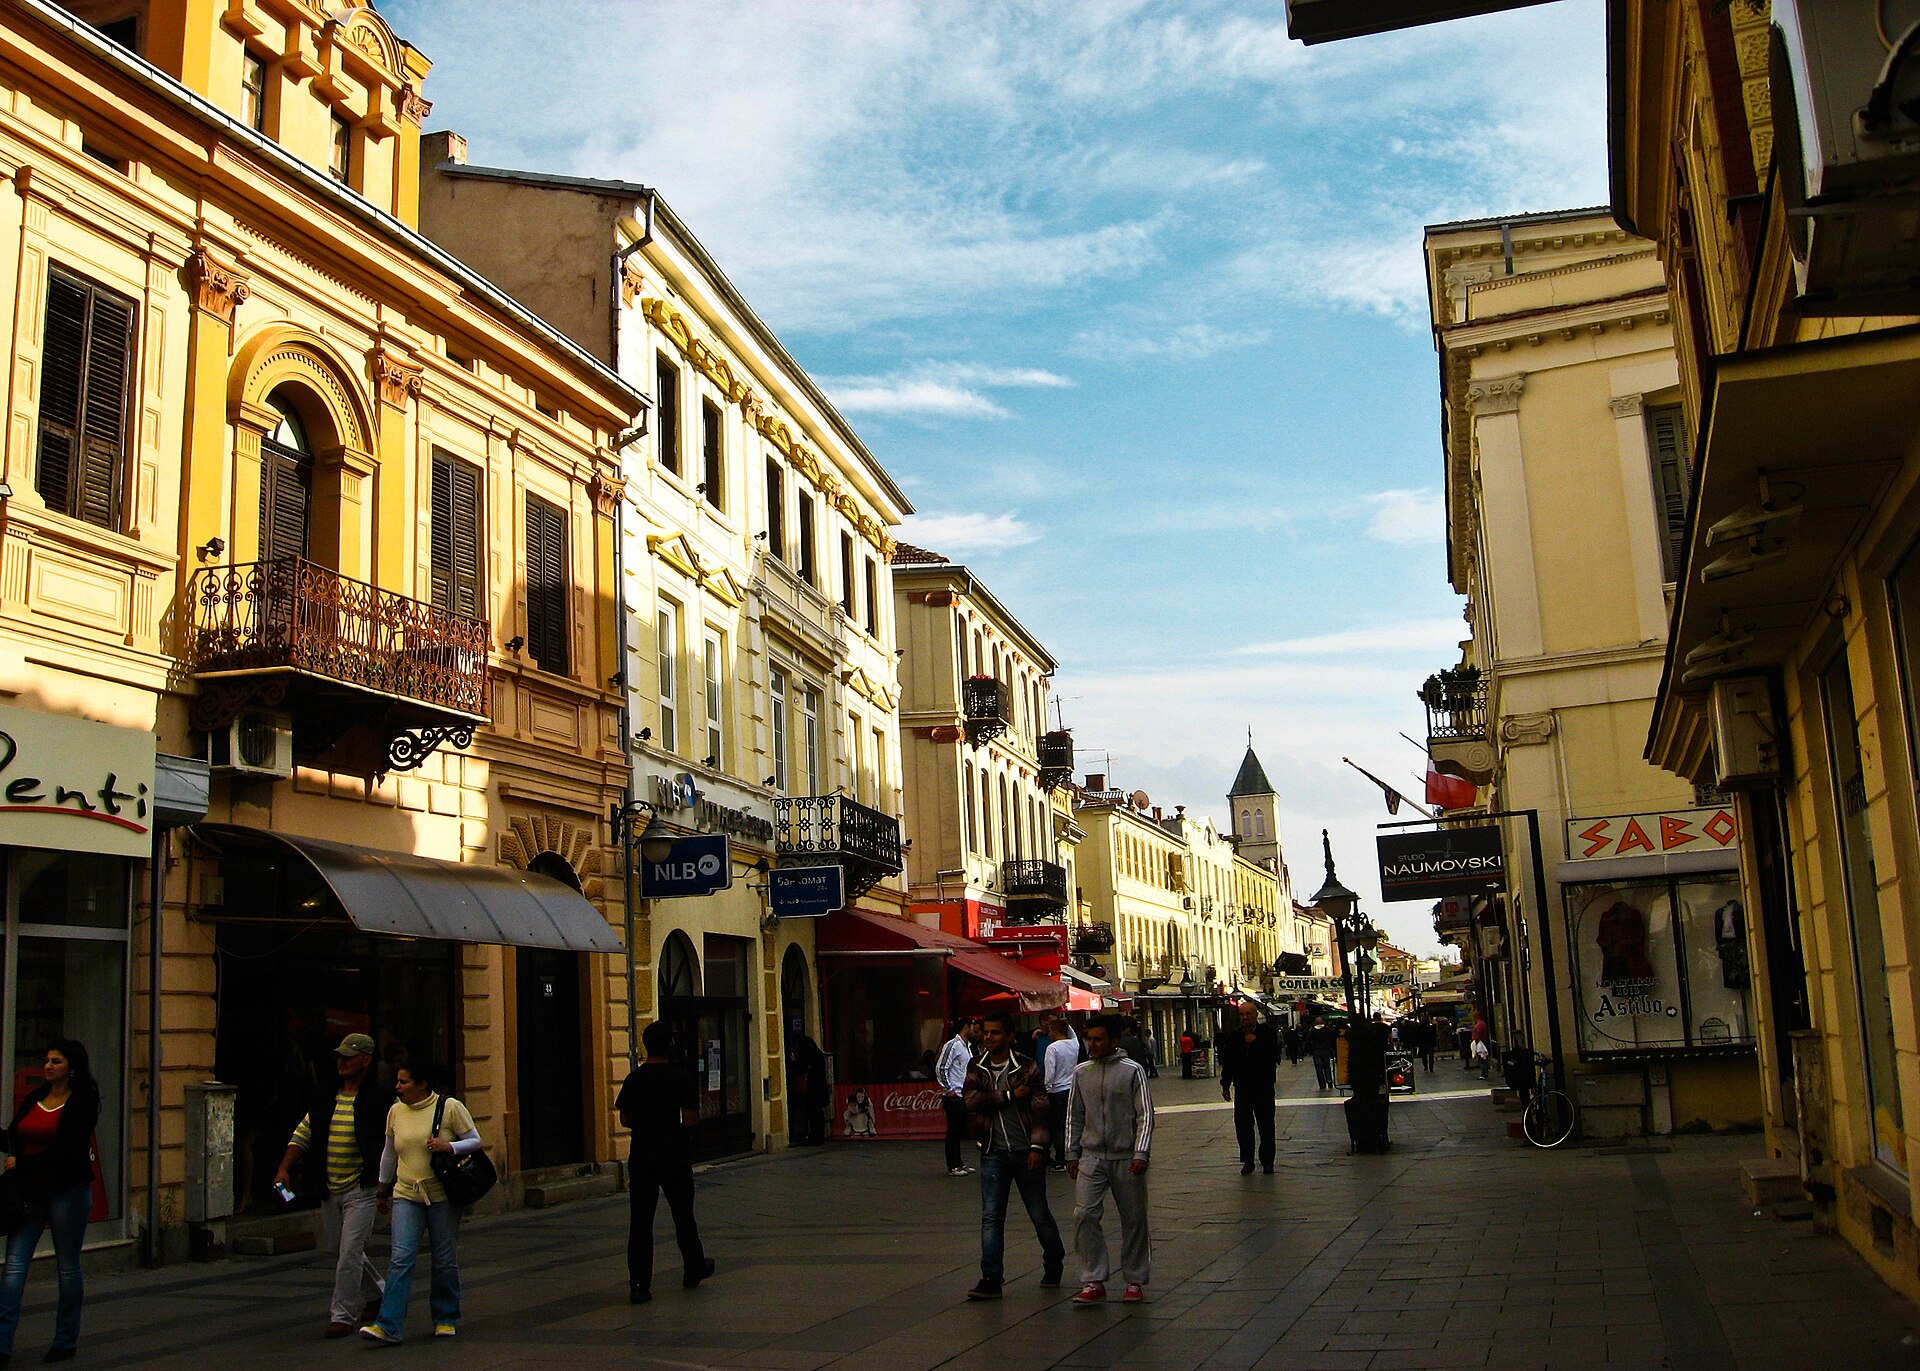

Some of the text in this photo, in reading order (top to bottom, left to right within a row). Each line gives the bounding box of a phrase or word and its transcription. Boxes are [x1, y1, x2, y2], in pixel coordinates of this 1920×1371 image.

[0, 731, 148, 818] enti
[1578, 810, 1737, 857] SABO
[1383, 855, 1501, 877] NAUMOVSKI
[1398, 853, 1426, 862] STUDIO
[655, 863, 697, 881] NLB
[777, 876, 827, 886] Баномат
[1279, 979, 1329, 990] СОЛЕНА
[1616, 987, 1641, 996] 2013
[1593, 994, 1663, 1022] Astibo
